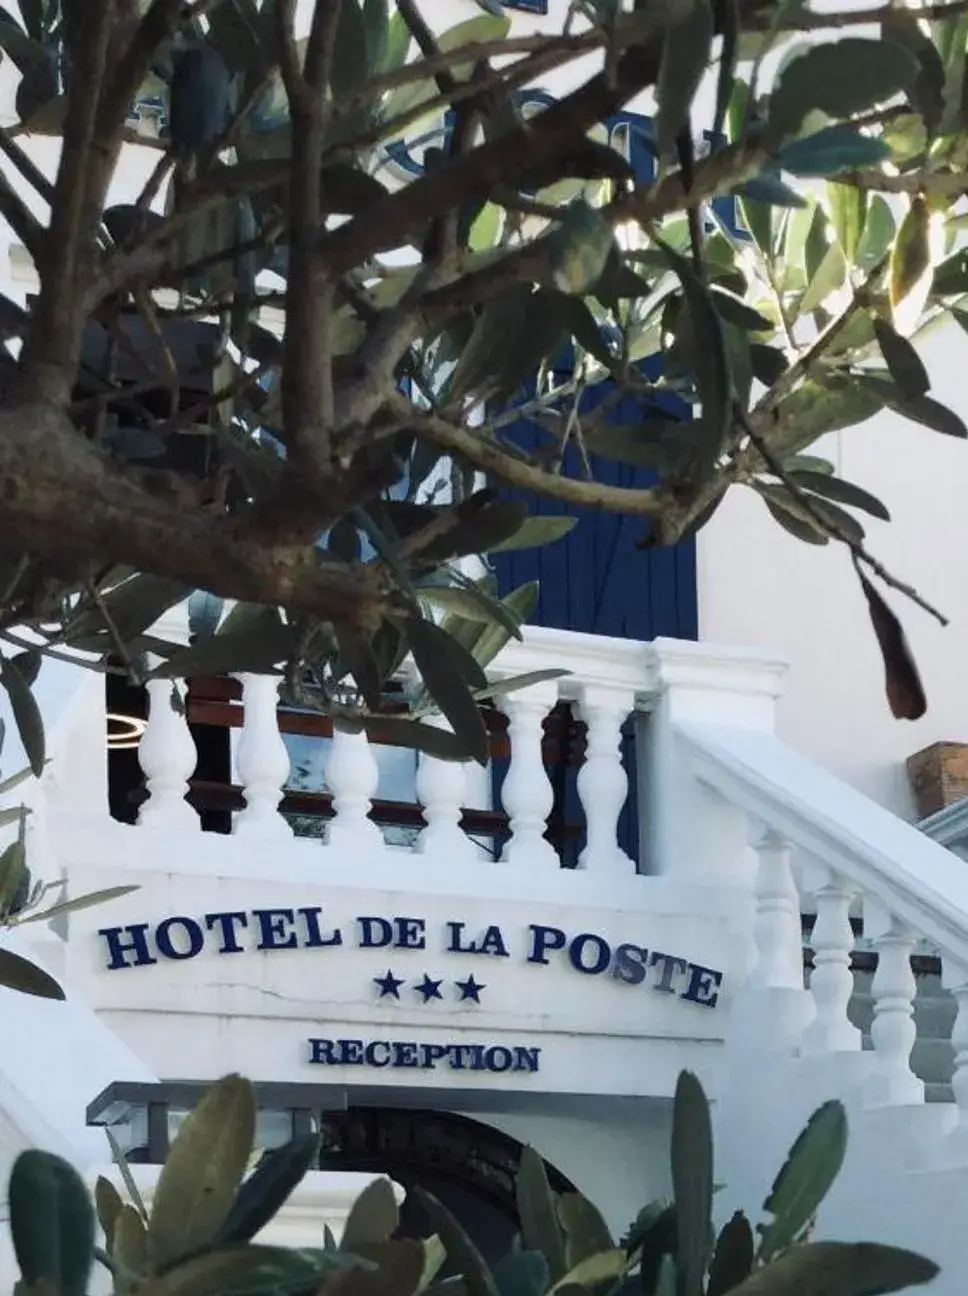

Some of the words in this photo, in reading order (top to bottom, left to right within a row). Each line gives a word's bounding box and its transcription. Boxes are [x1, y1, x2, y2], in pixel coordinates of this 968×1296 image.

[97, 906, 342, 970] HOTEL
[356, 916, 426, 950] DE
[446, 921, 510, 958] LA
[525, 923, 723, 1010] POSTE
[307, 1038, 541, 1074] RECEPTION
